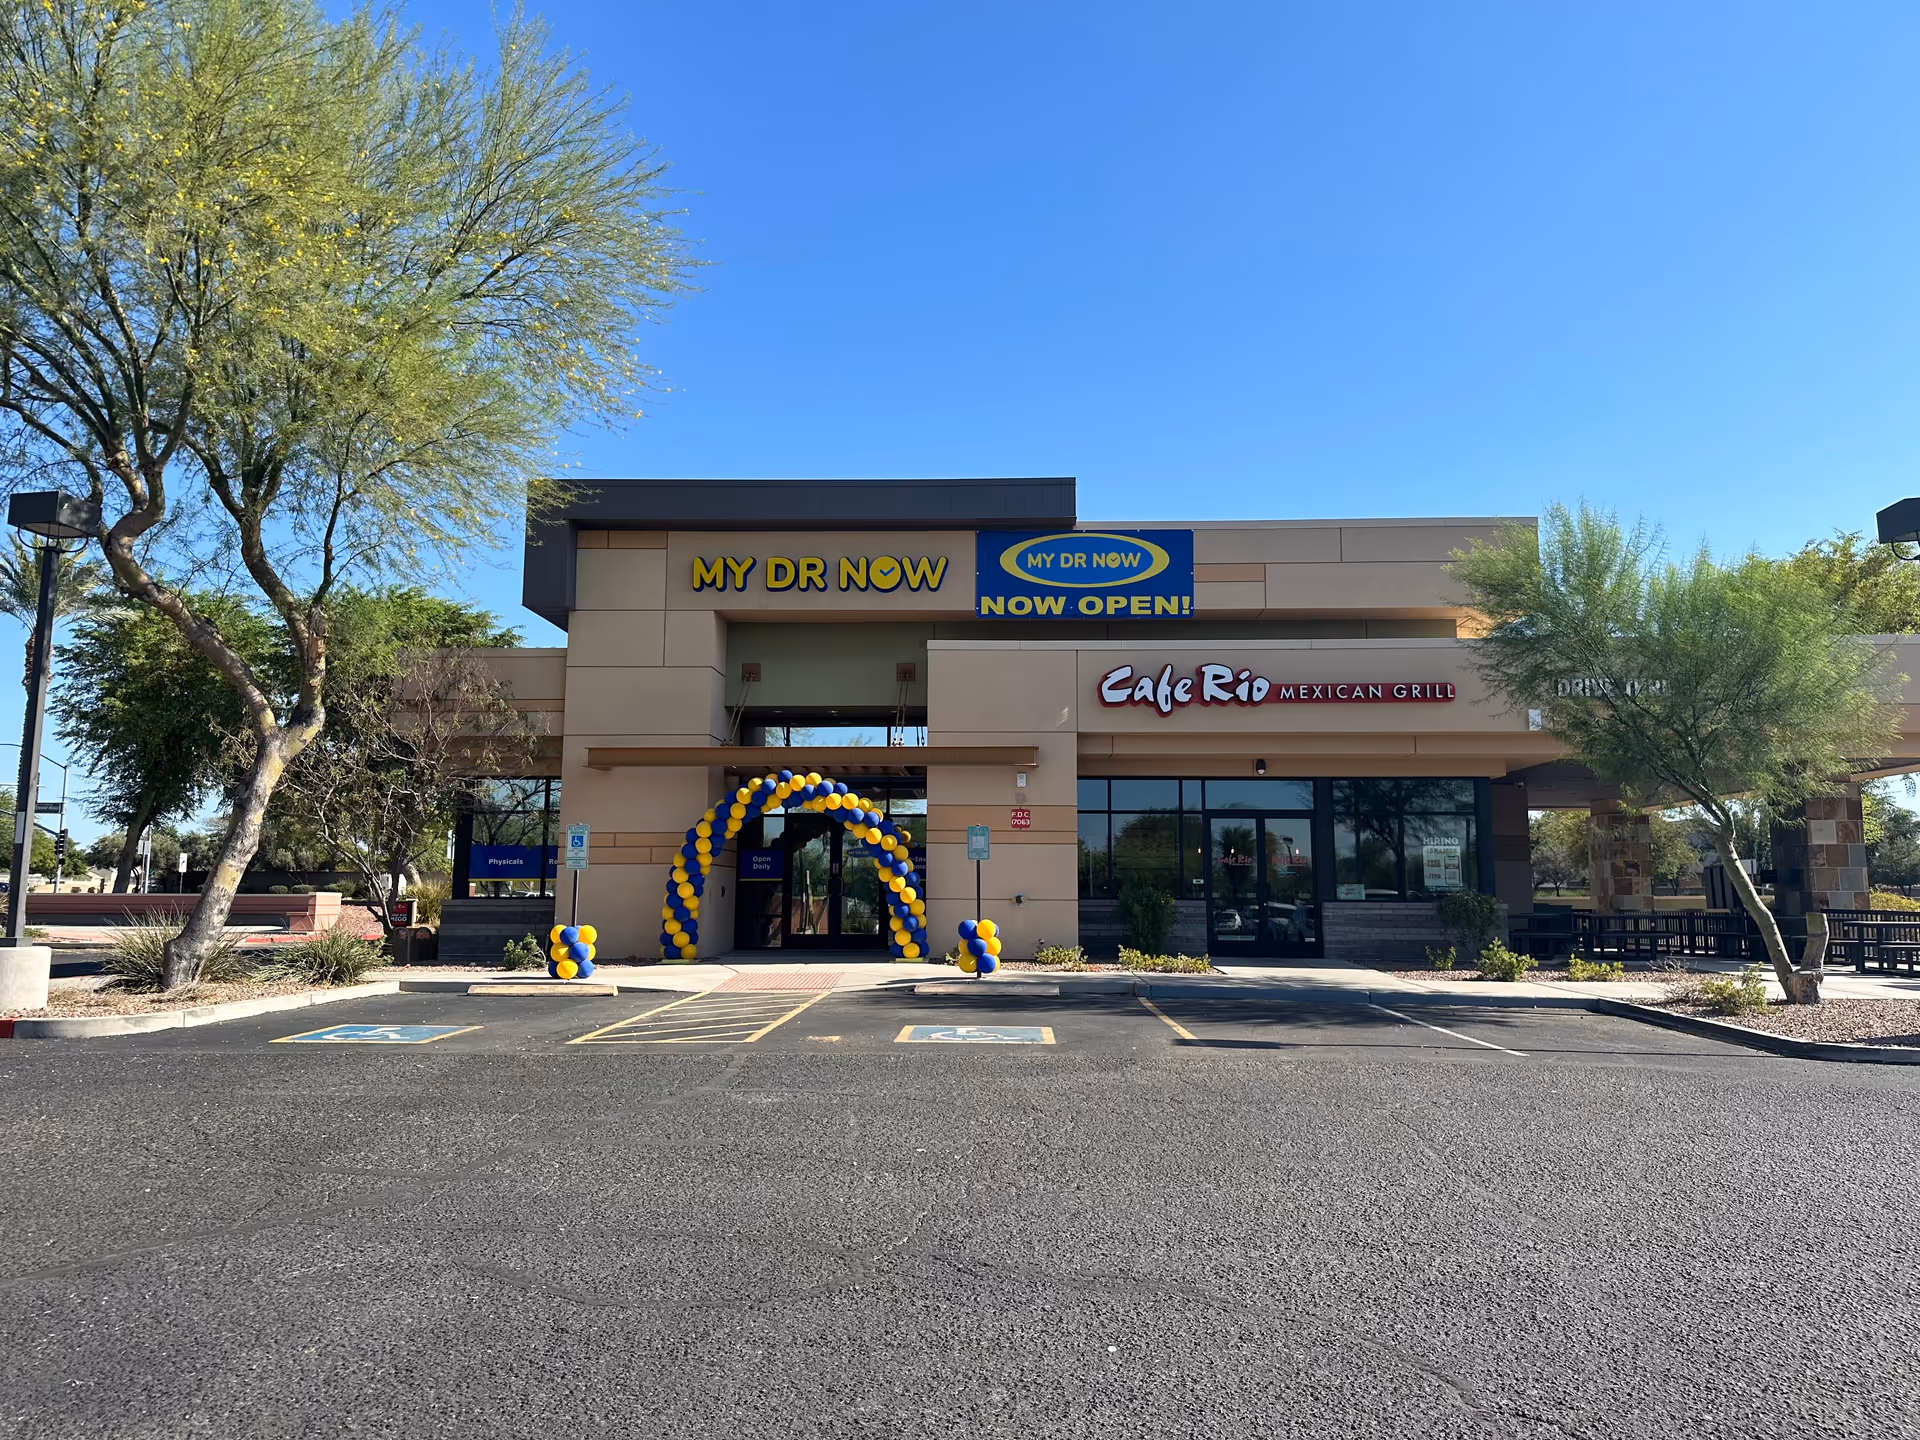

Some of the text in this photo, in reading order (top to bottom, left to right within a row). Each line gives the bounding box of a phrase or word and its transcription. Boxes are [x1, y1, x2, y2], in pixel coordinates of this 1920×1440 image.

[1027, 552, 1141, 568] MY DR NOW
[693, 555, 949, 593] MY DR NOW
[981, 596, 1190, 615] NOW OPEN!
[1100, 664, 1271, 713] Cafe Rio
[1280, 684, 1455, 699] MEXICAN GRILL
[1423, 837, 1459, 845] HIRING
[753, 863, 771, 871] Daily
